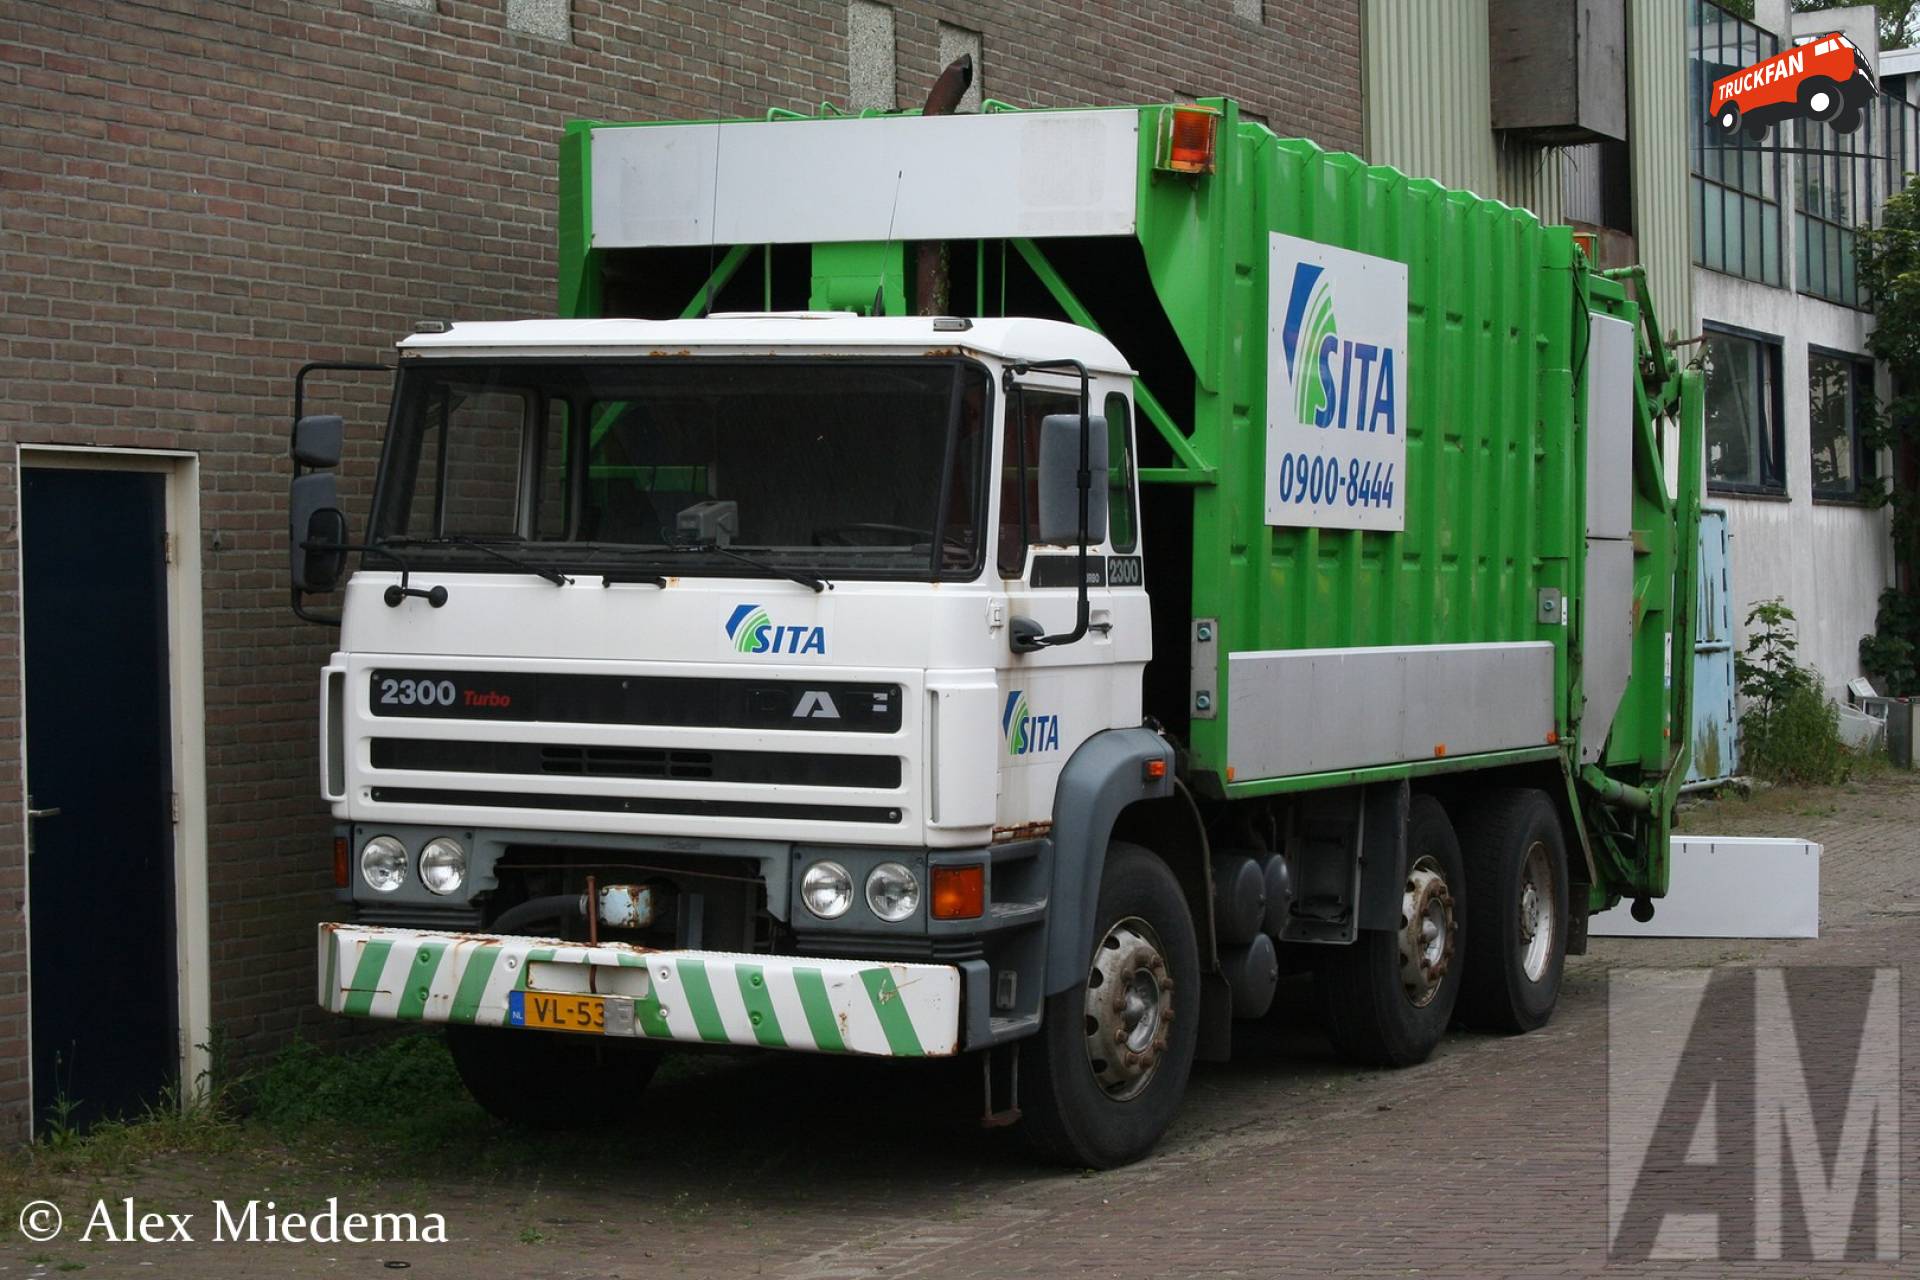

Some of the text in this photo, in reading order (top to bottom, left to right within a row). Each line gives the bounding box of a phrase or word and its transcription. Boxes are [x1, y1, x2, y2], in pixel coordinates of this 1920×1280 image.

[1315, 332, 1396, 435] SITA
[1279, 452, 1395, 509] 0900-8444
[1109, 558, 1139, 584] 2300
[751, 625, 826, 655] SITA
[380, 678, 513, 707] 2300 Turbo
[1017, 714, 1059, 755] SITA
[512, 1011, 523, 1020] NL
